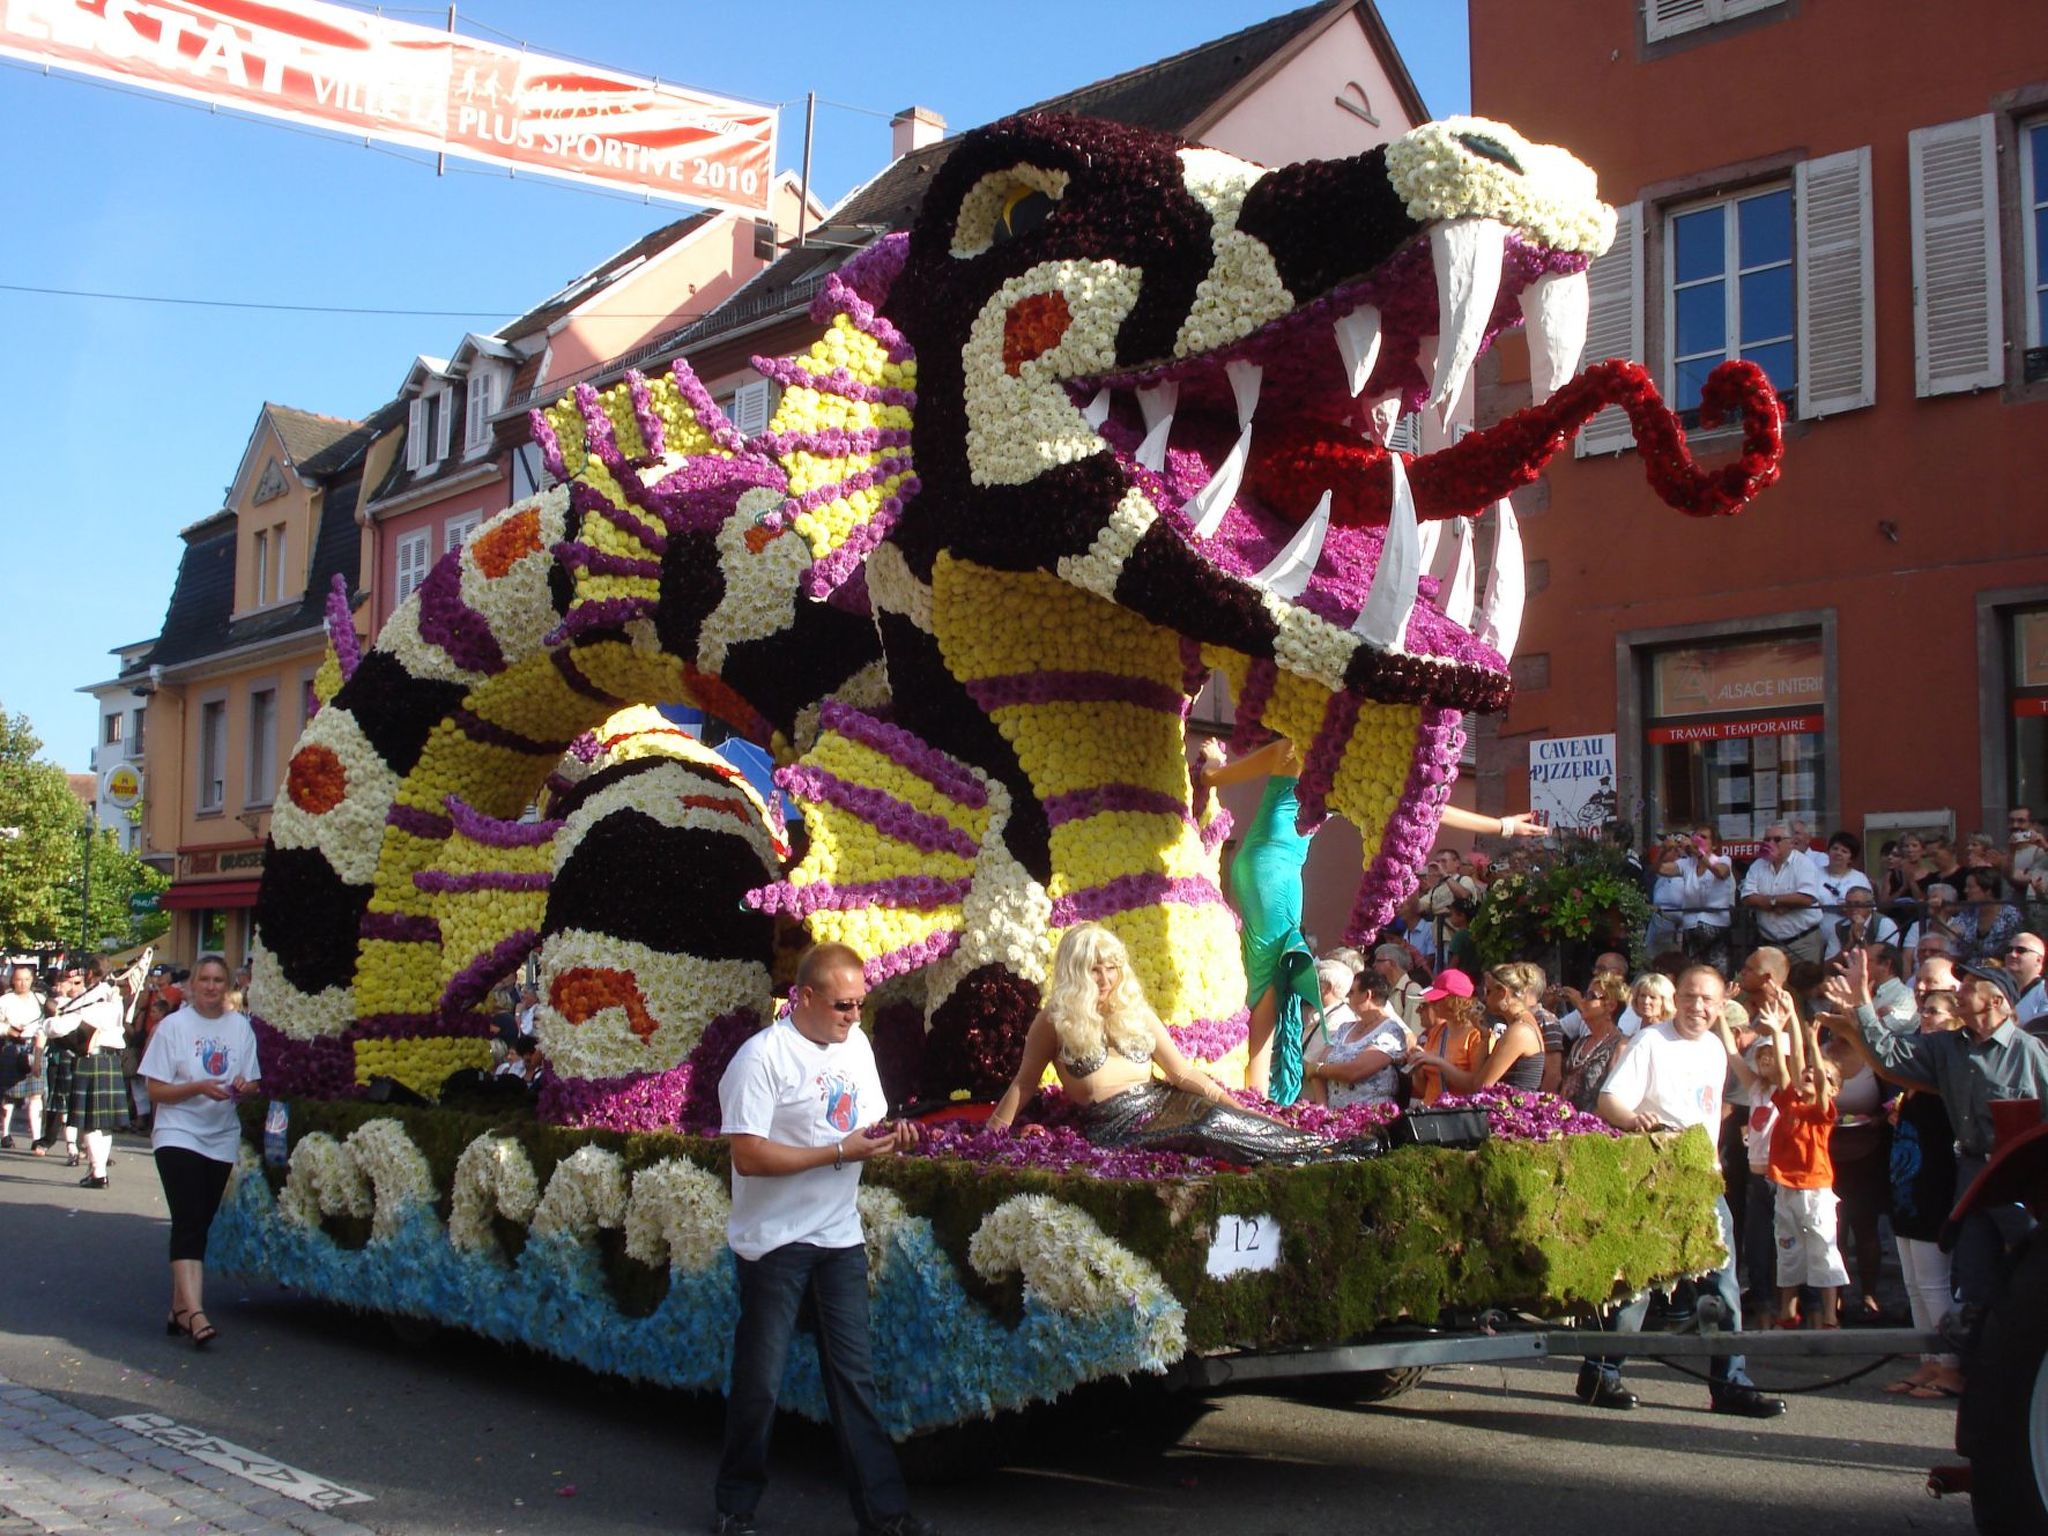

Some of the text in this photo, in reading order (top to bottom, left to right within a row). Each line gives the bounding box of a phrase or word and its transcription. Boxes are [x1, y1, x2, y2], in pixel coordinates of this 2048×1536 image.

[458, 105, 535, 149] PLUS
[542, 130, 684, 182] SPORTIVE
[691, 159, 758, 196] 2010
[1718, 679, 1774, 699] ALSACE
[1669, 719, 1806, 741] TRAVAIL TEMPORAIRE
[1539, 738, 1603, 760] CAVEAU
[1532, 758, 1614, 781] PIZZERIA
[1233, 1218, 1260, 1253] 12
